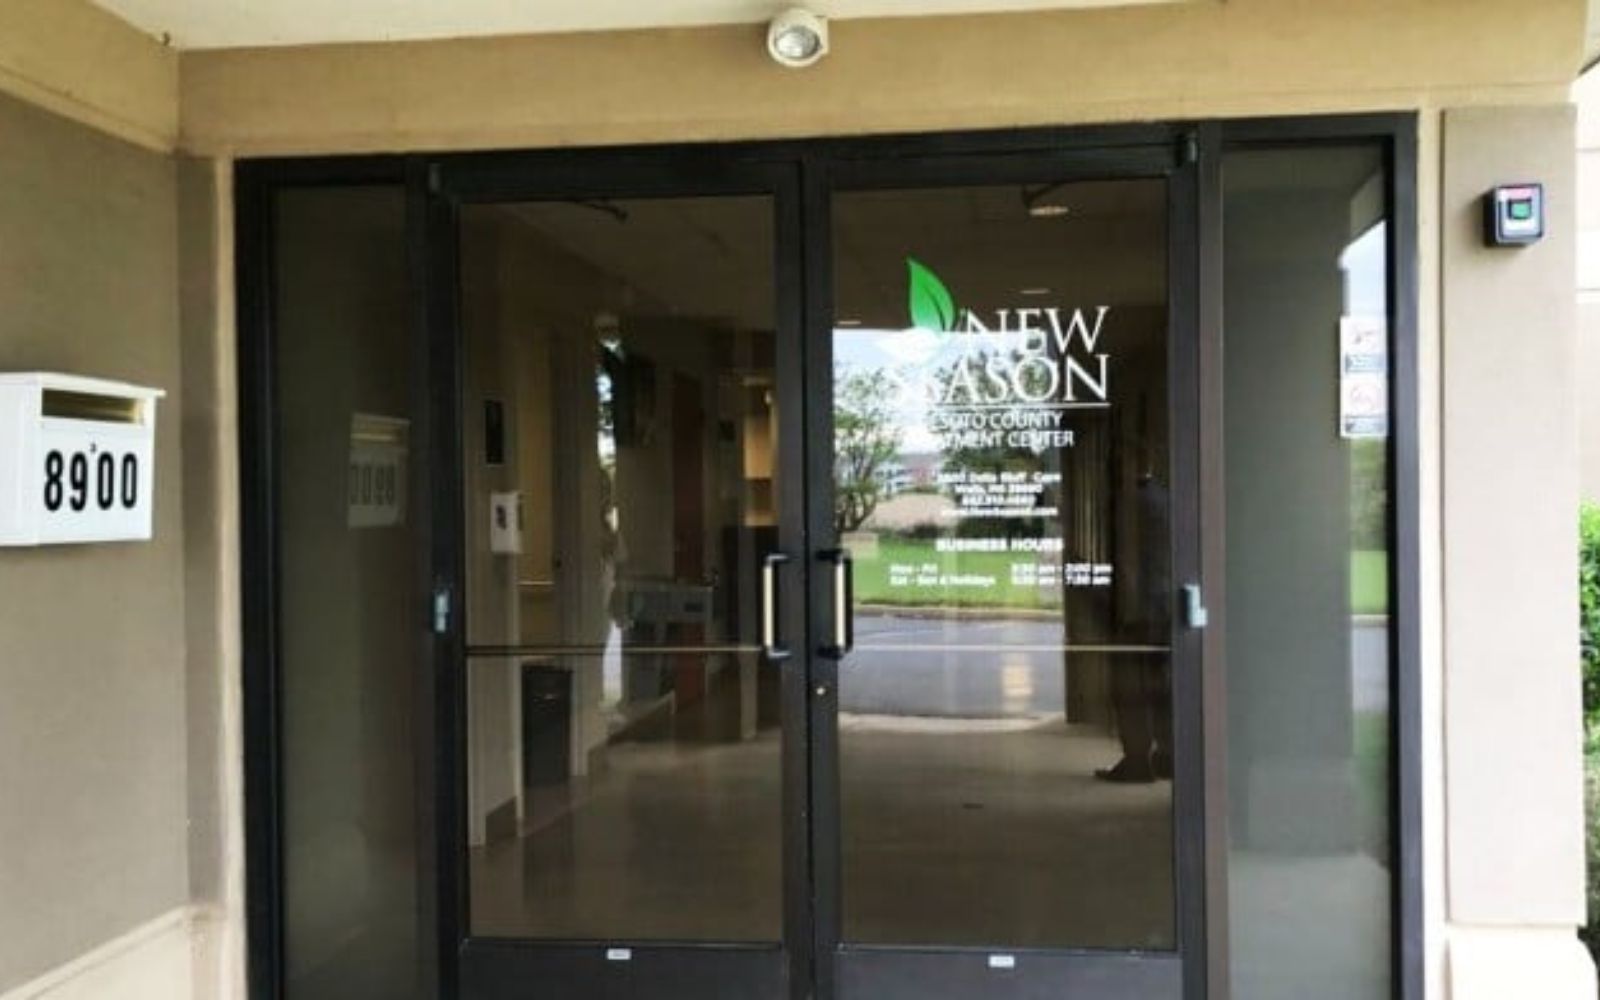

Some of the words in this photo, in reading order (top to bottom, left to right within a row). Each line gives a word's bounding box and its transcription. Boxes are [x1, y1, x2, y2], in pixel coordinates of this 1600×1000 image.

[960, 306, 1110, 354] NEW
[892, 354, 1110, 403] ASON
[928, 411, 987, 429] SOTO
[990, 411, 1064, 429] COUNTY
[1007, 430, 1075, 448] CENTER
[44, 450, 138, 511] 8900
[936, 538, 1007, 552] BUSINESS
[1011, 538, 1063, 552] HOURS
